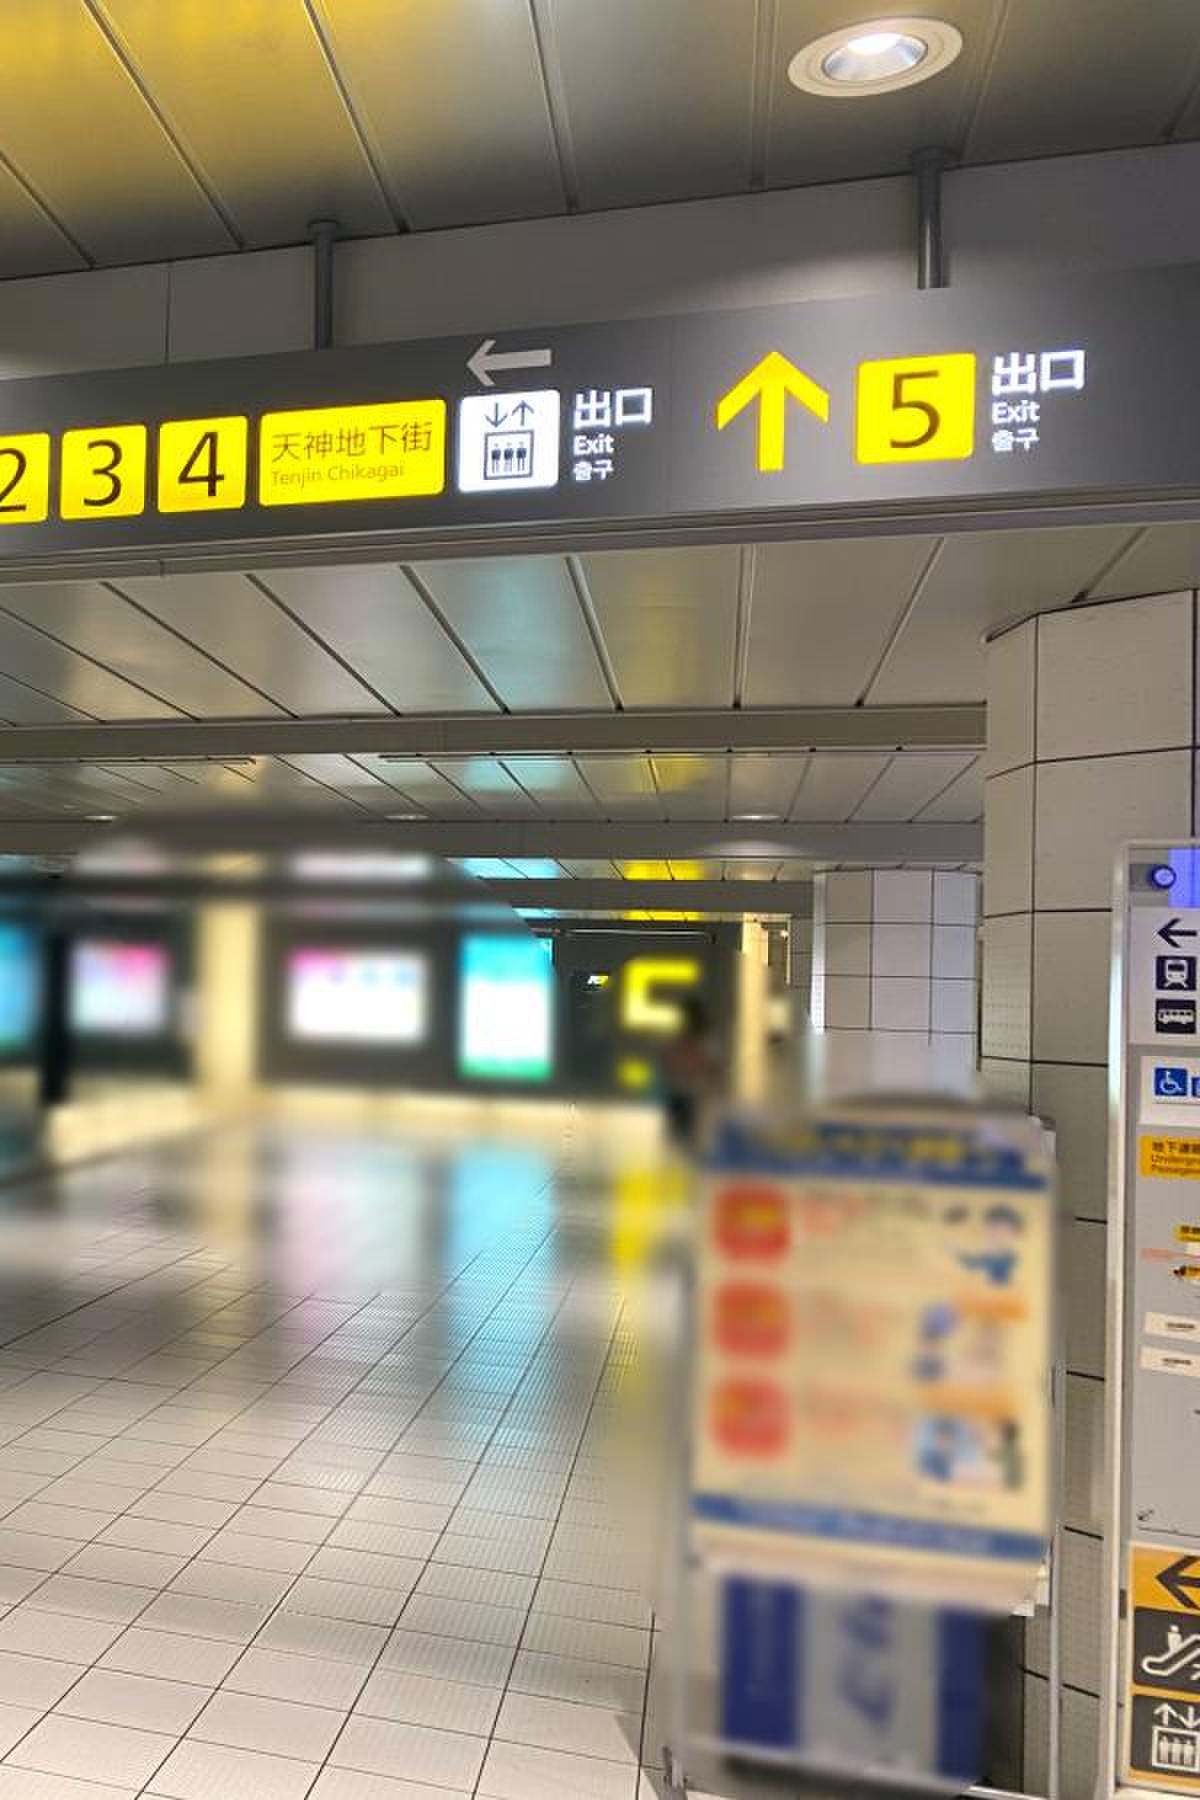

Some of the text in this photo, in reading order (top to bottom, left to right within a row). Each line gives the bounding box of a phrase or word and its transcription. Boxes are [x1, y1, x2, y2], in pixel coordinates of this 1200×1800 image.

[992, 350, 1085, 395] 出口
[574, 388, 652, 429] 出口
[890, 370, 940, 449] 5
[992, 400, 1040, 424] Exit
[272, 421, 433, 463] 天神地下街
[573, 433, 615, 456] Exit
[83, 440, 123, 507] 3
[177, 431, 225, 497] 4
[272, 463, 404, 489] Tenjin Chikagai
